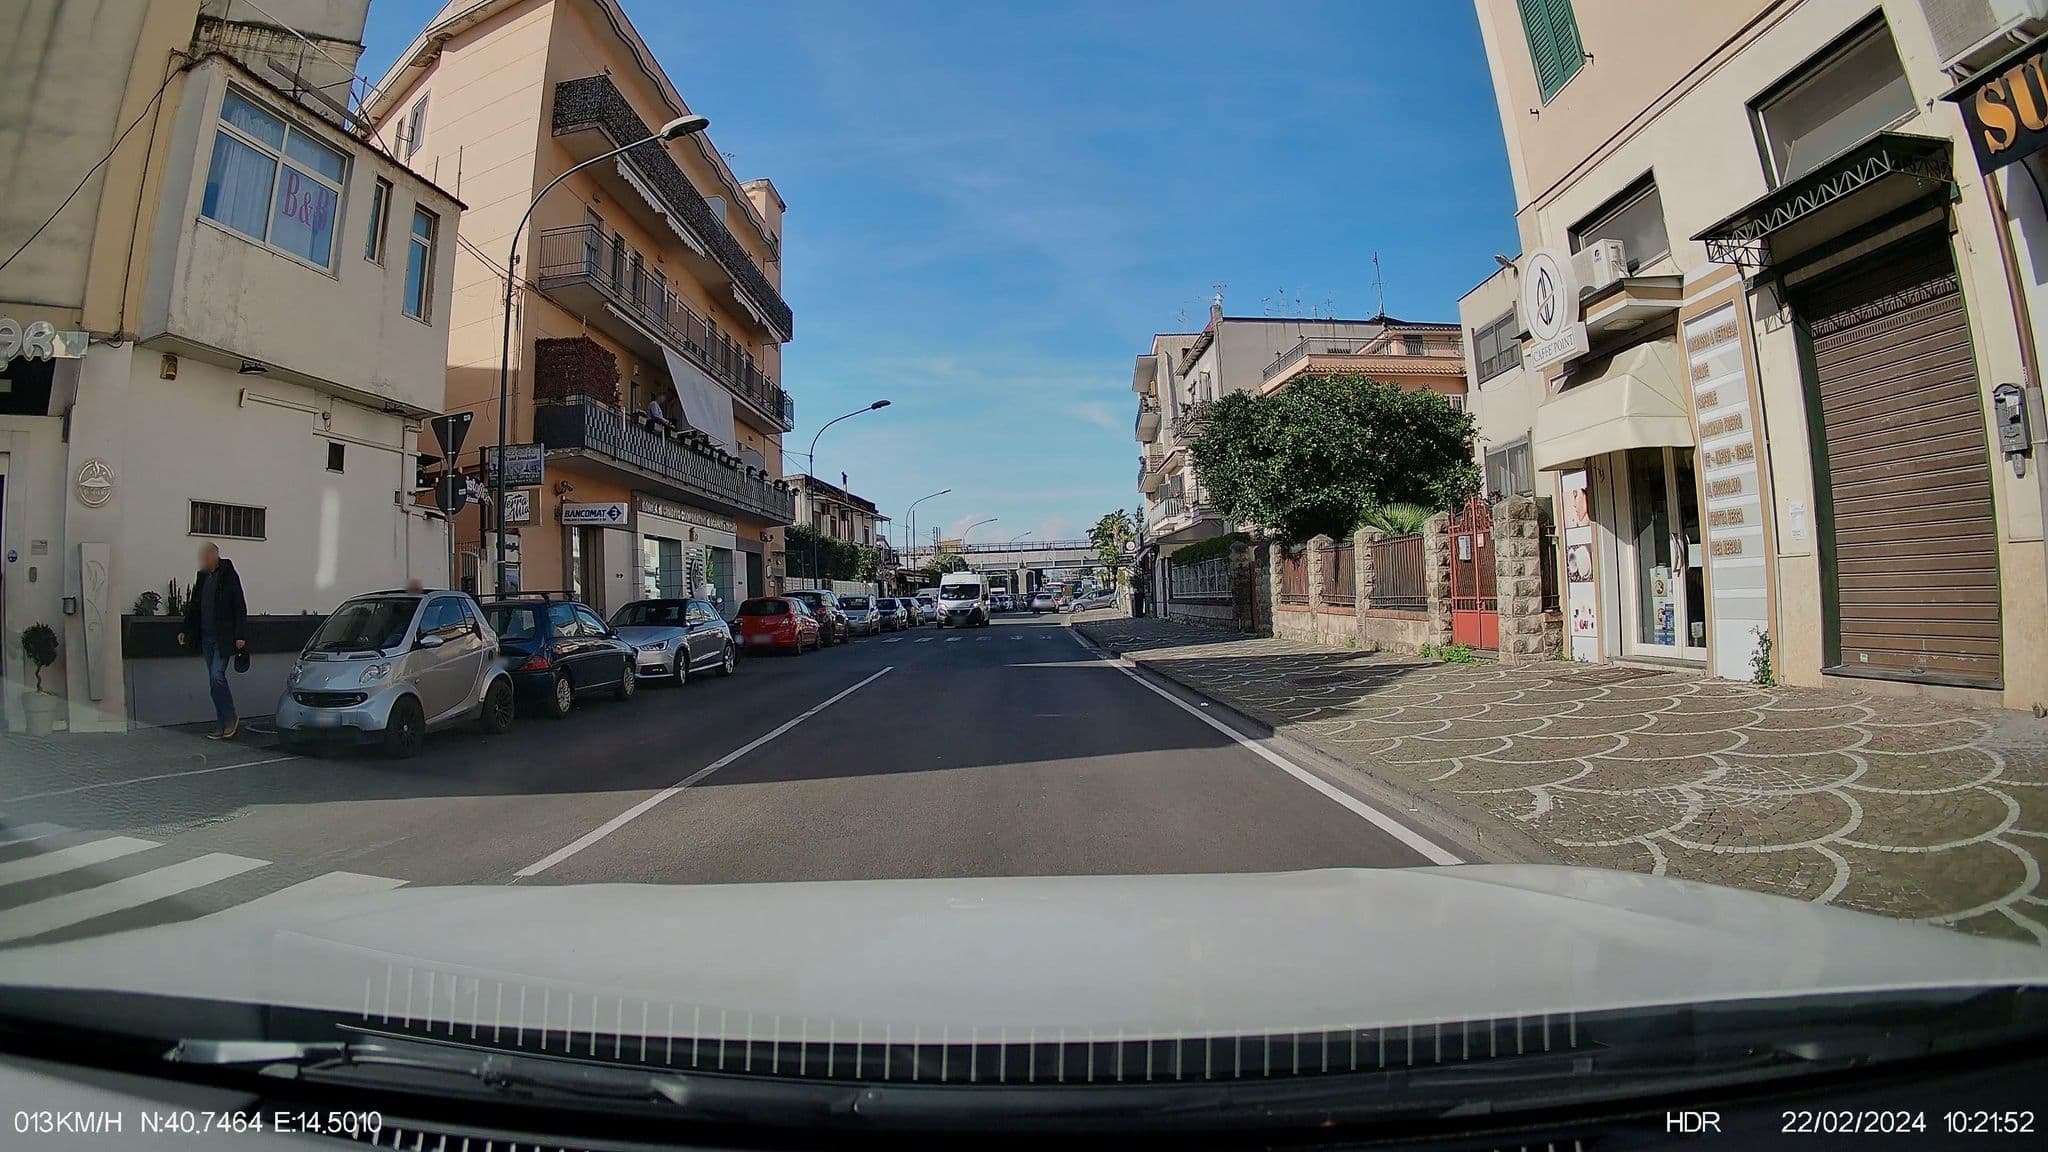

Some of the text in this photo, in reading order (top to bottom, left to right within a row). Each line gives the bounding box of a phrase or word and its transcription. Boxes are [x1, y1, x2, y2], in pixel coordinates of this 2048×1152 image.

[282, 169, 330, 231] B&B
[1554, 334, 1574, 355] POINT
[564, 508, 606, 519] BANCOMAT
